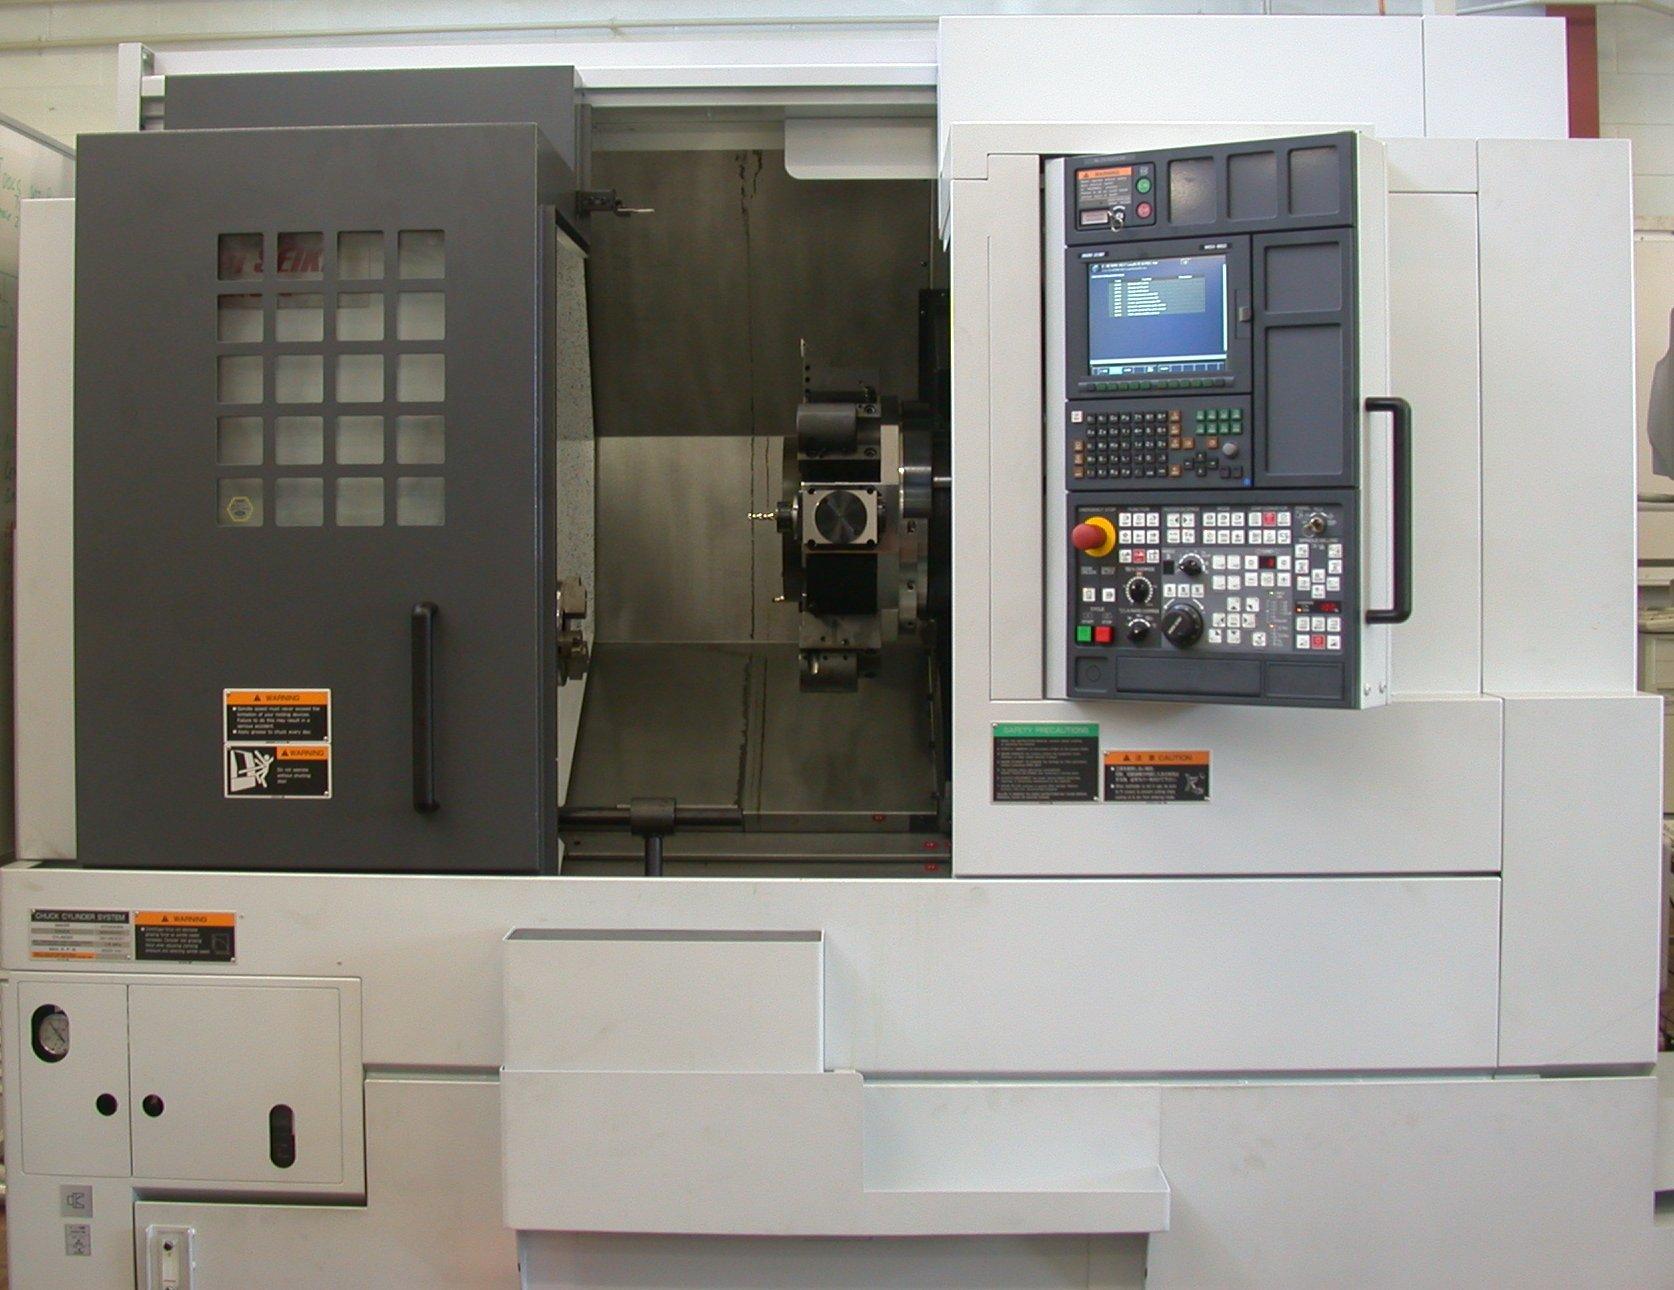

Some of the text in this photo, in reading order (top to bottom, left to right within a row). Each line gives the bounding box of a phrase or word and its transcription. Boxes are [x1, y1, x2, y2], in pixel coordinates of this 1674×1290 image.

[35, 912, 126, 922] CHUCK CYLINDER SYSTEM
[173, 915, 208, 923] WARNING
